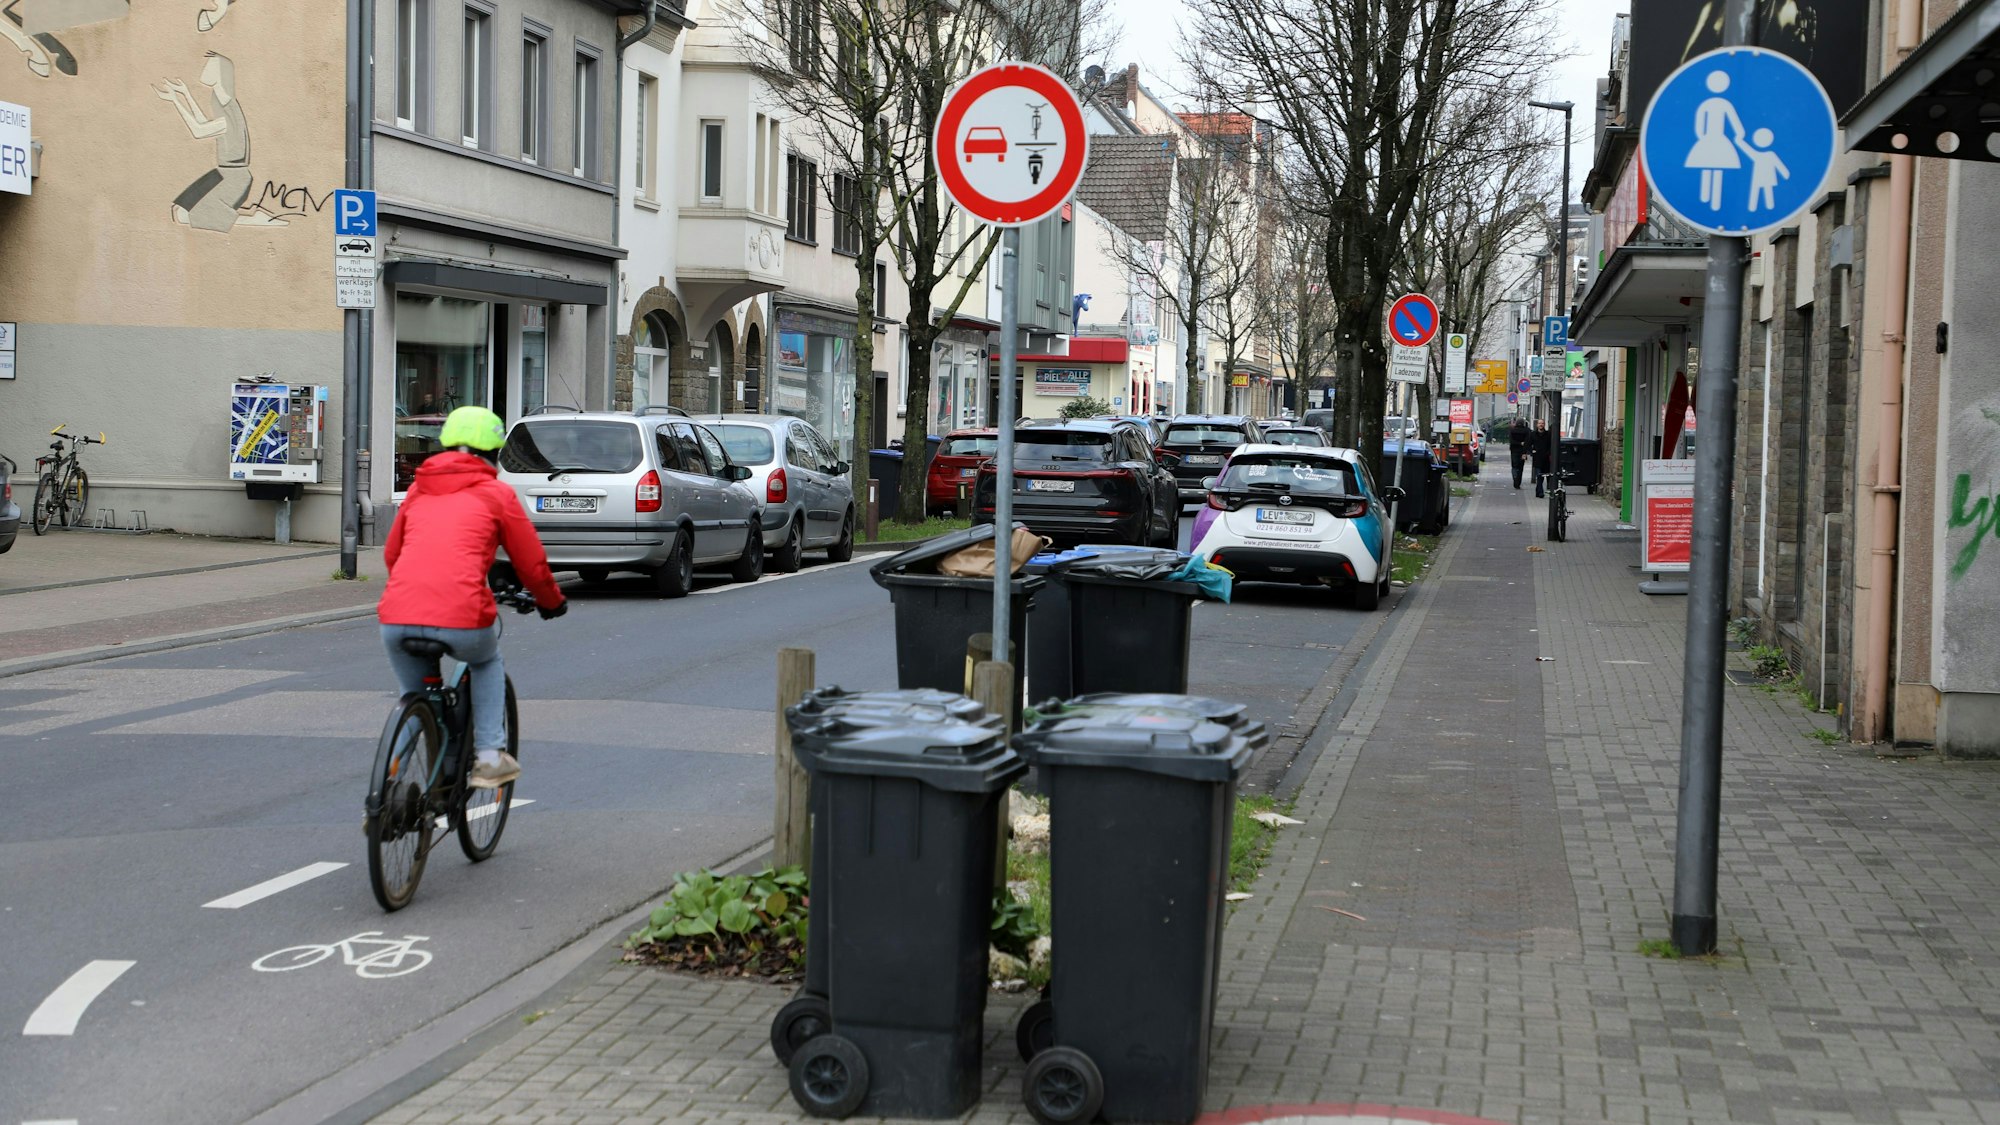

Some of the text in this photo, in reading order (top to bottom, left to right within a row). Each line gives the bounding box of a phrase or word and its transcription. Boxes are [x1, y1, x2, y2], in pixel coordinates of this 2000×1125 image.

[0, 144, 26, 178] ER
[341, 195, 364, 230] P
[338, 278, 373, 288] werktags
[1549, 320, 1563, 343] P
[1394, 367, 1422, 377] Ladezone
[543, 498, 555, 508] GL
[1262, 510, 1279, 520] LEV
